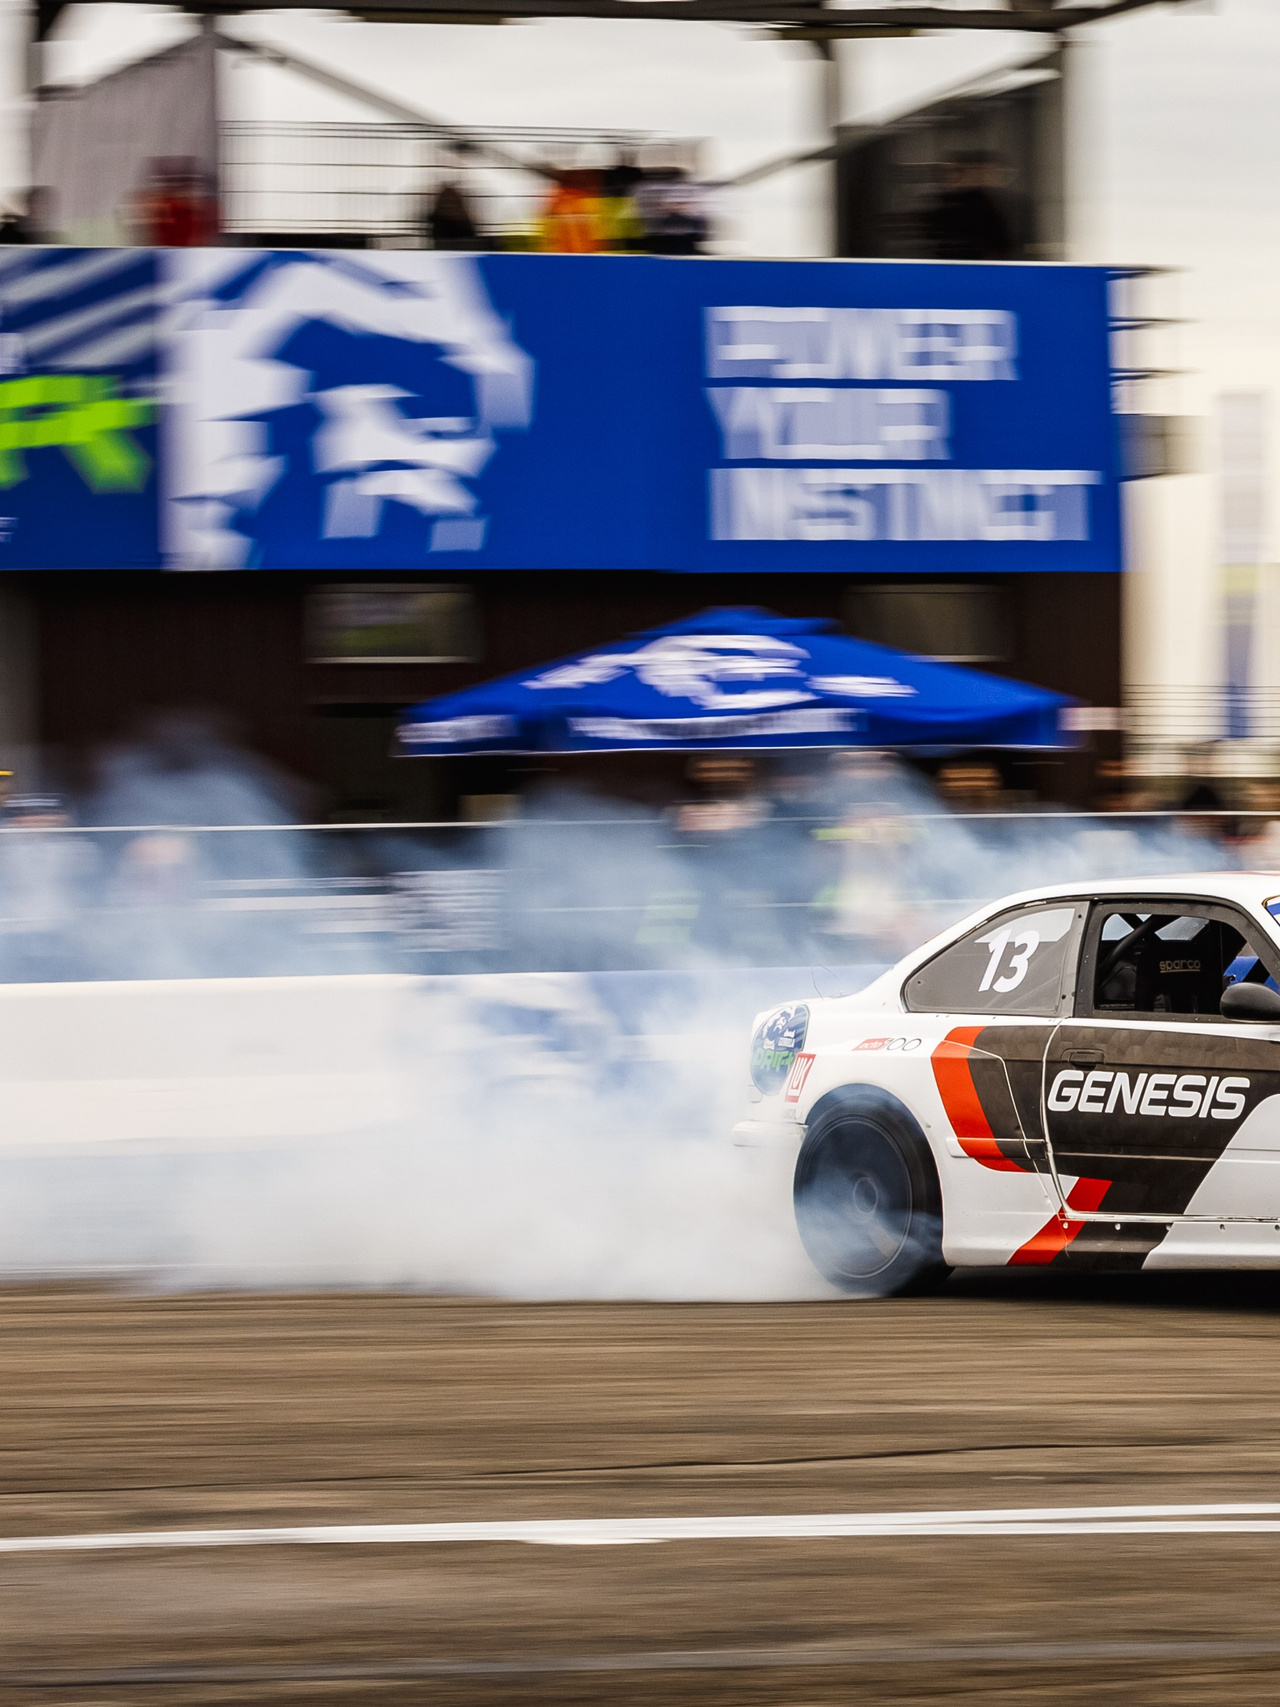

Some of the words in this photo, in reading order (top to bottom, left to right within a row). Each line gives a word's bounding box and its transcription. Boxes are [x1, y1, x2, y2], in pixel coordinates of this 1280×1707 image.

[978, 928, 1041, 993] 13
[1159, 960, 1201, 972] sparco
[1047, 1069, 1251, 1120] GENESIS
